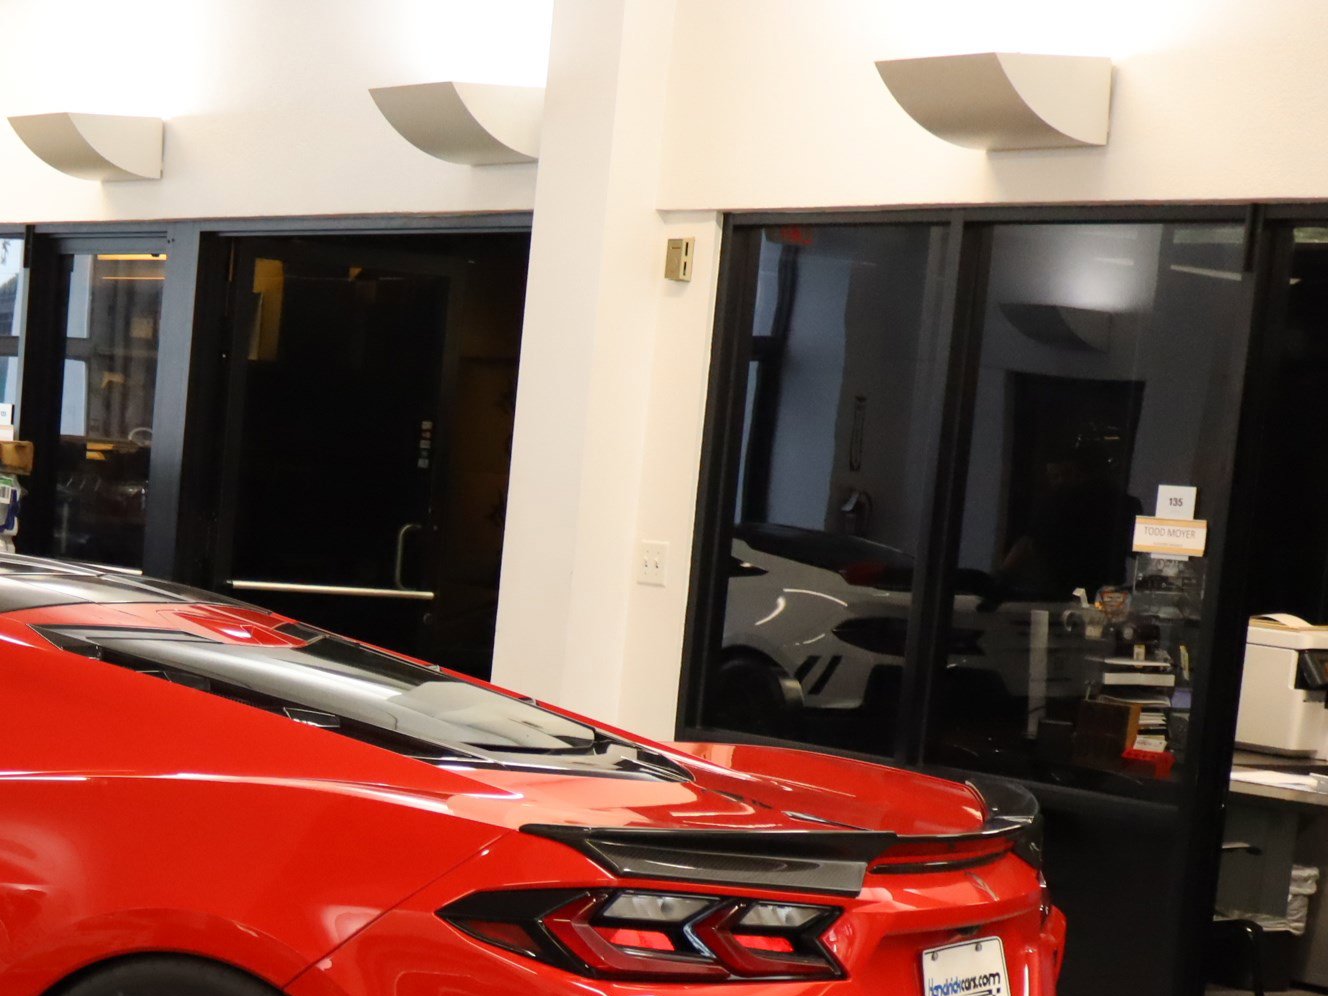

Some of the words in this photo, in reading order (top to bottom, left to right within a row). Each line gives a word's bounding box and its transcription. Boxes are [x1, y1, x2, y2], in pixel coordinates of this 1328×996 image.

[1169, 497, 1183, 507] 135
[1144, 526, 1166, 537] TODD
[1167, 528, 1197, 539] MOYER
